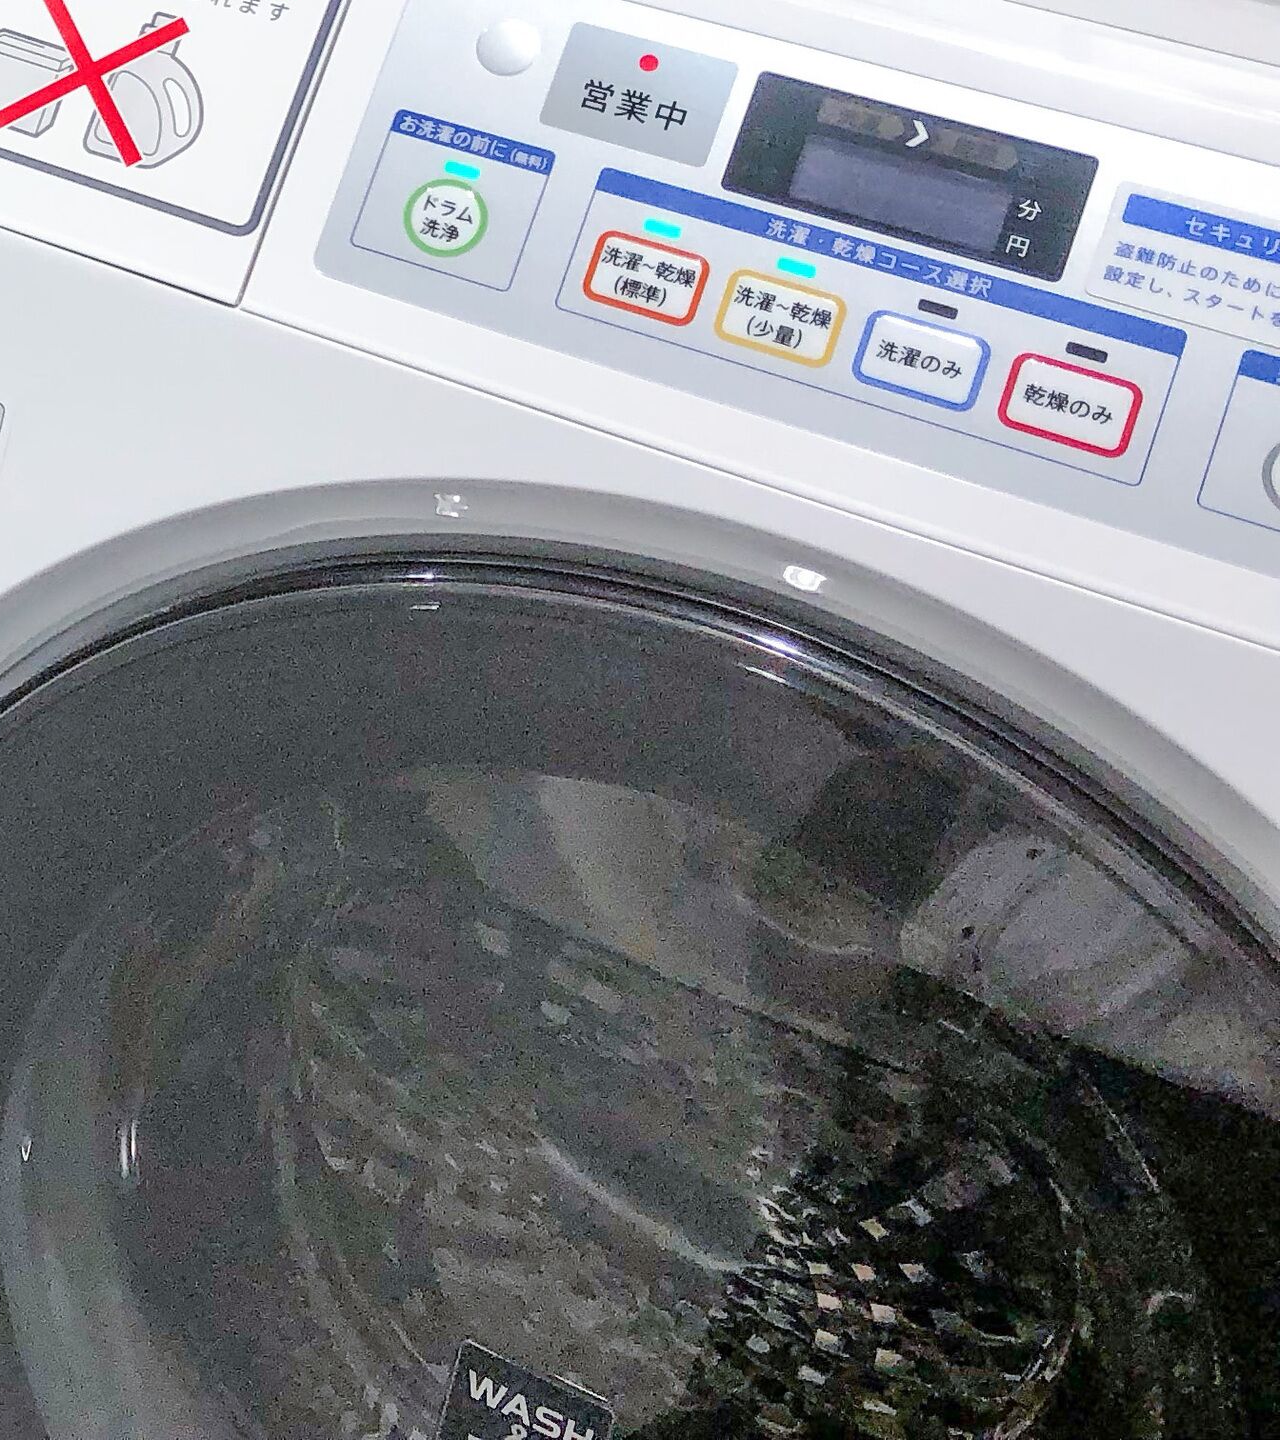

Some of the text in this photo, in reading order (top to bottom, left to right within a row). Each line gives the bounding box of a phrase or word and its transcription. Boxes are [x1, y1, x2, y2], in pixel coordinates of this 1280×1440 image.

[580, 79, 688, 131] 営業中
[398, 113, 506, 158] お洗濯の前に
[423, 195, 473, 224] ドラム
[1018, 200, 1041, 221] 分
[422, 218, 459, 241] 洗浄
[1006, 235, 1030, 257] 円
[614, 275, 667, 306] (標準)
[746, 316, 802, 348] (少量)
[876, 339, 963, 379] 洗濯のみ
[1023, 383, 1114, 425] 乾燥のみ
